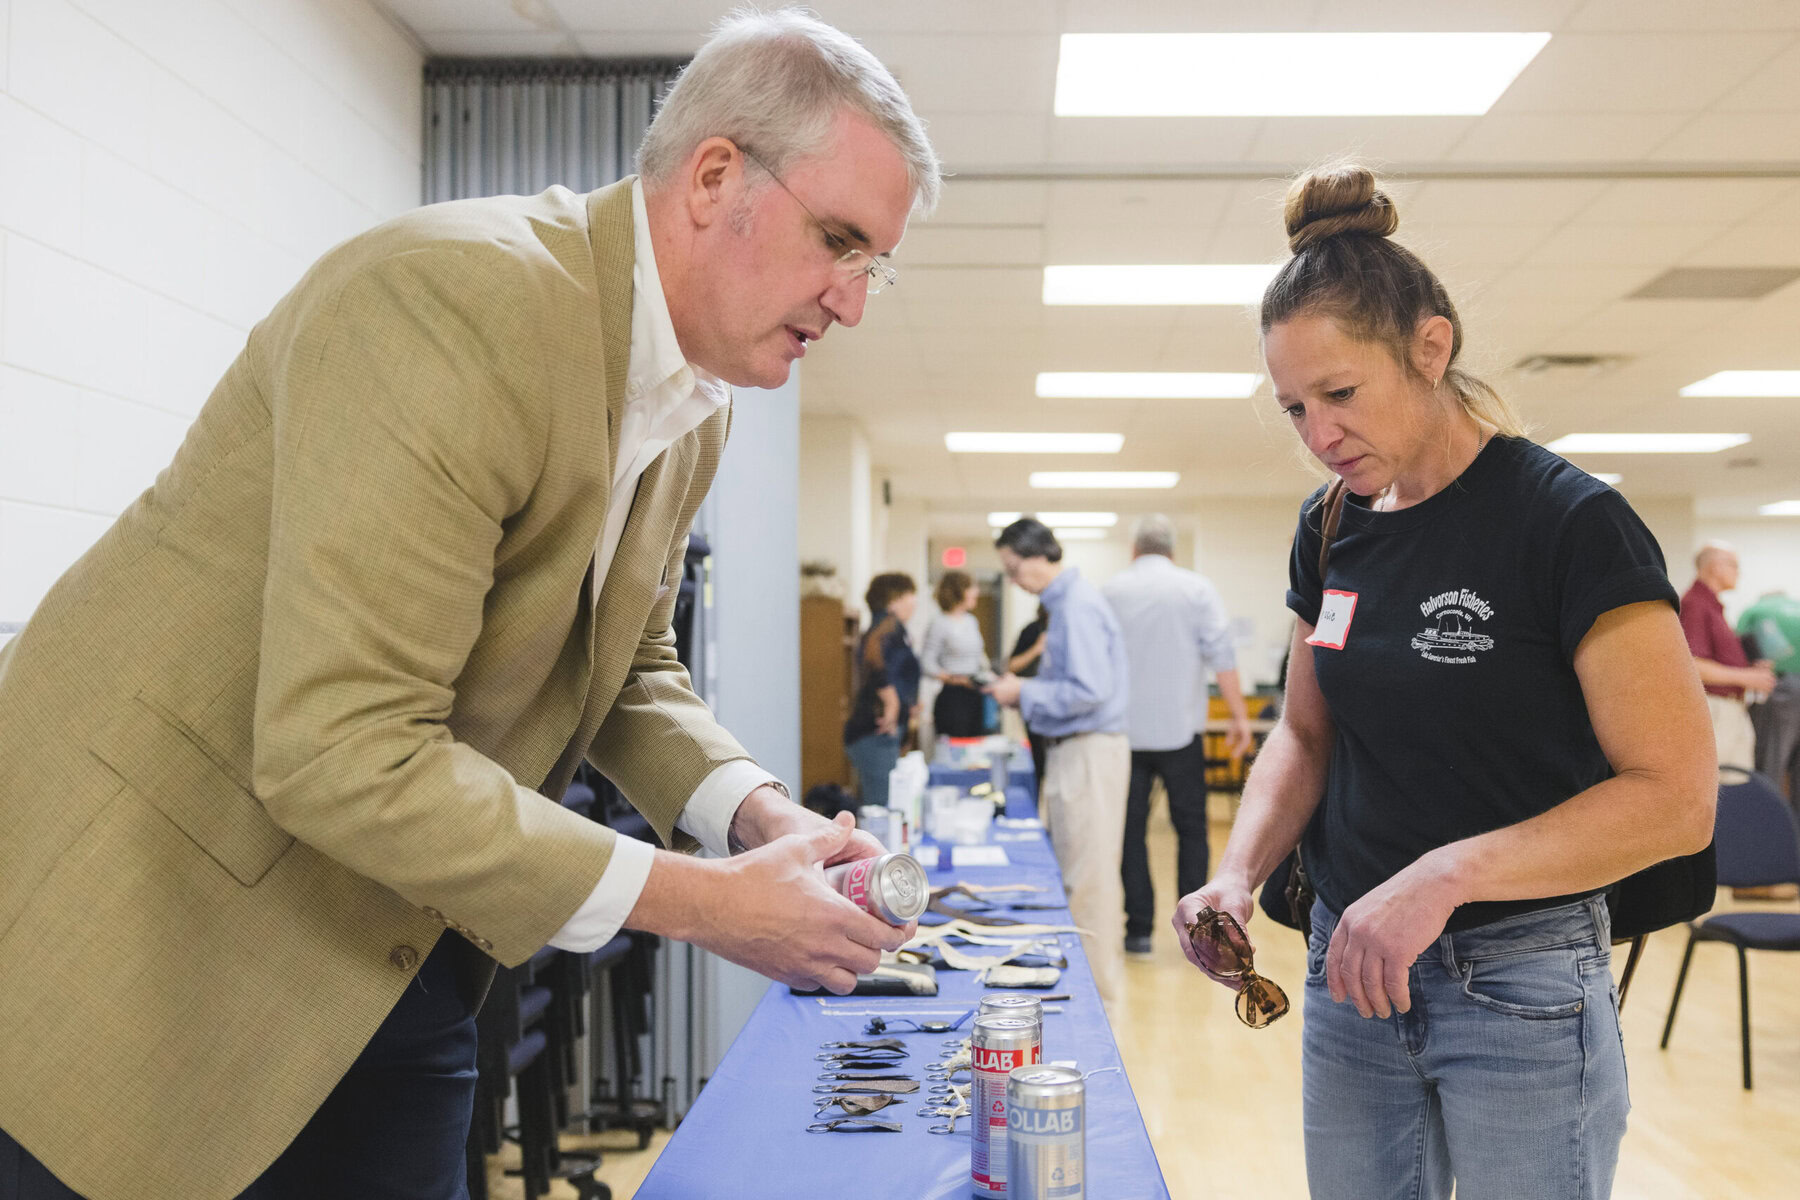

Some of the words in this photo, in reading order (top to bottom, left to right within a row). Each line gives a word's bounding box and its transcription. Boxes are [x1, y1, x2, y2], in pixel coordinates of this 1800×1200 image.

[1420, 591, 1459, 617] Halvorson
[1458, 588, 1494, 621] Fisheries
[1467, 655, 1476, 663] Fish
[971, 1047, 1014, 1071] LLAB
